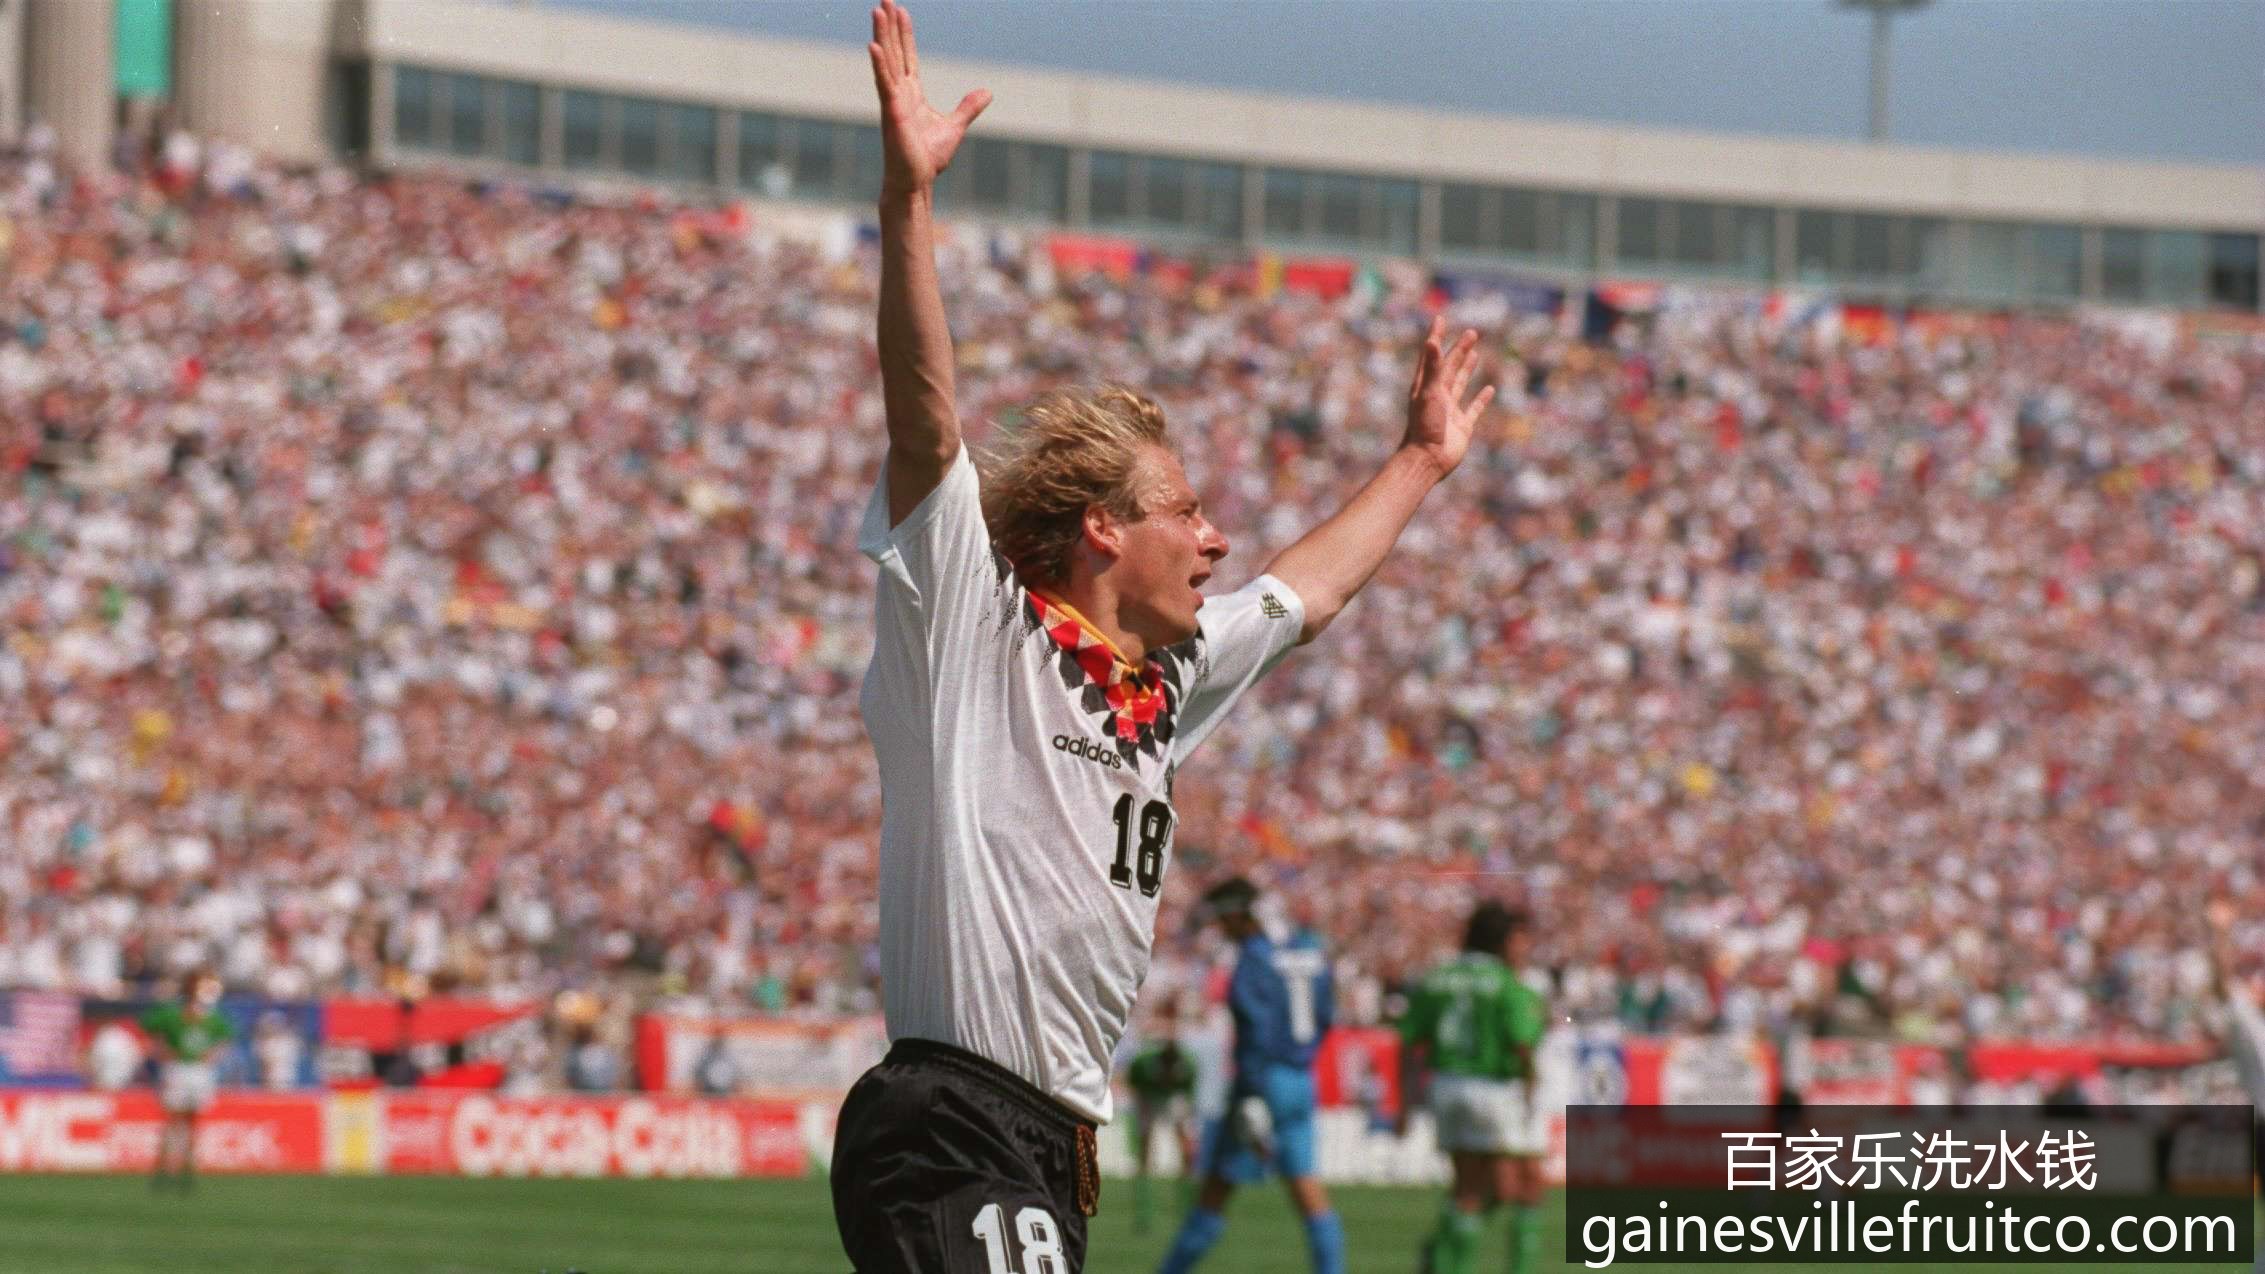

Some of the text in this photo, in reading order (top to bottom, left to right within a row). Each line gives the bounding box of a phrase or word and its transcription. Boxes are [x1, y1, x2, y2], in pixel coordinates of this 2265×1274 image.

[1052, 733, 1122, 769] adidas
[1110, 793, 1172, 898] 18
[972, 1203, 1069, 1274] 18
